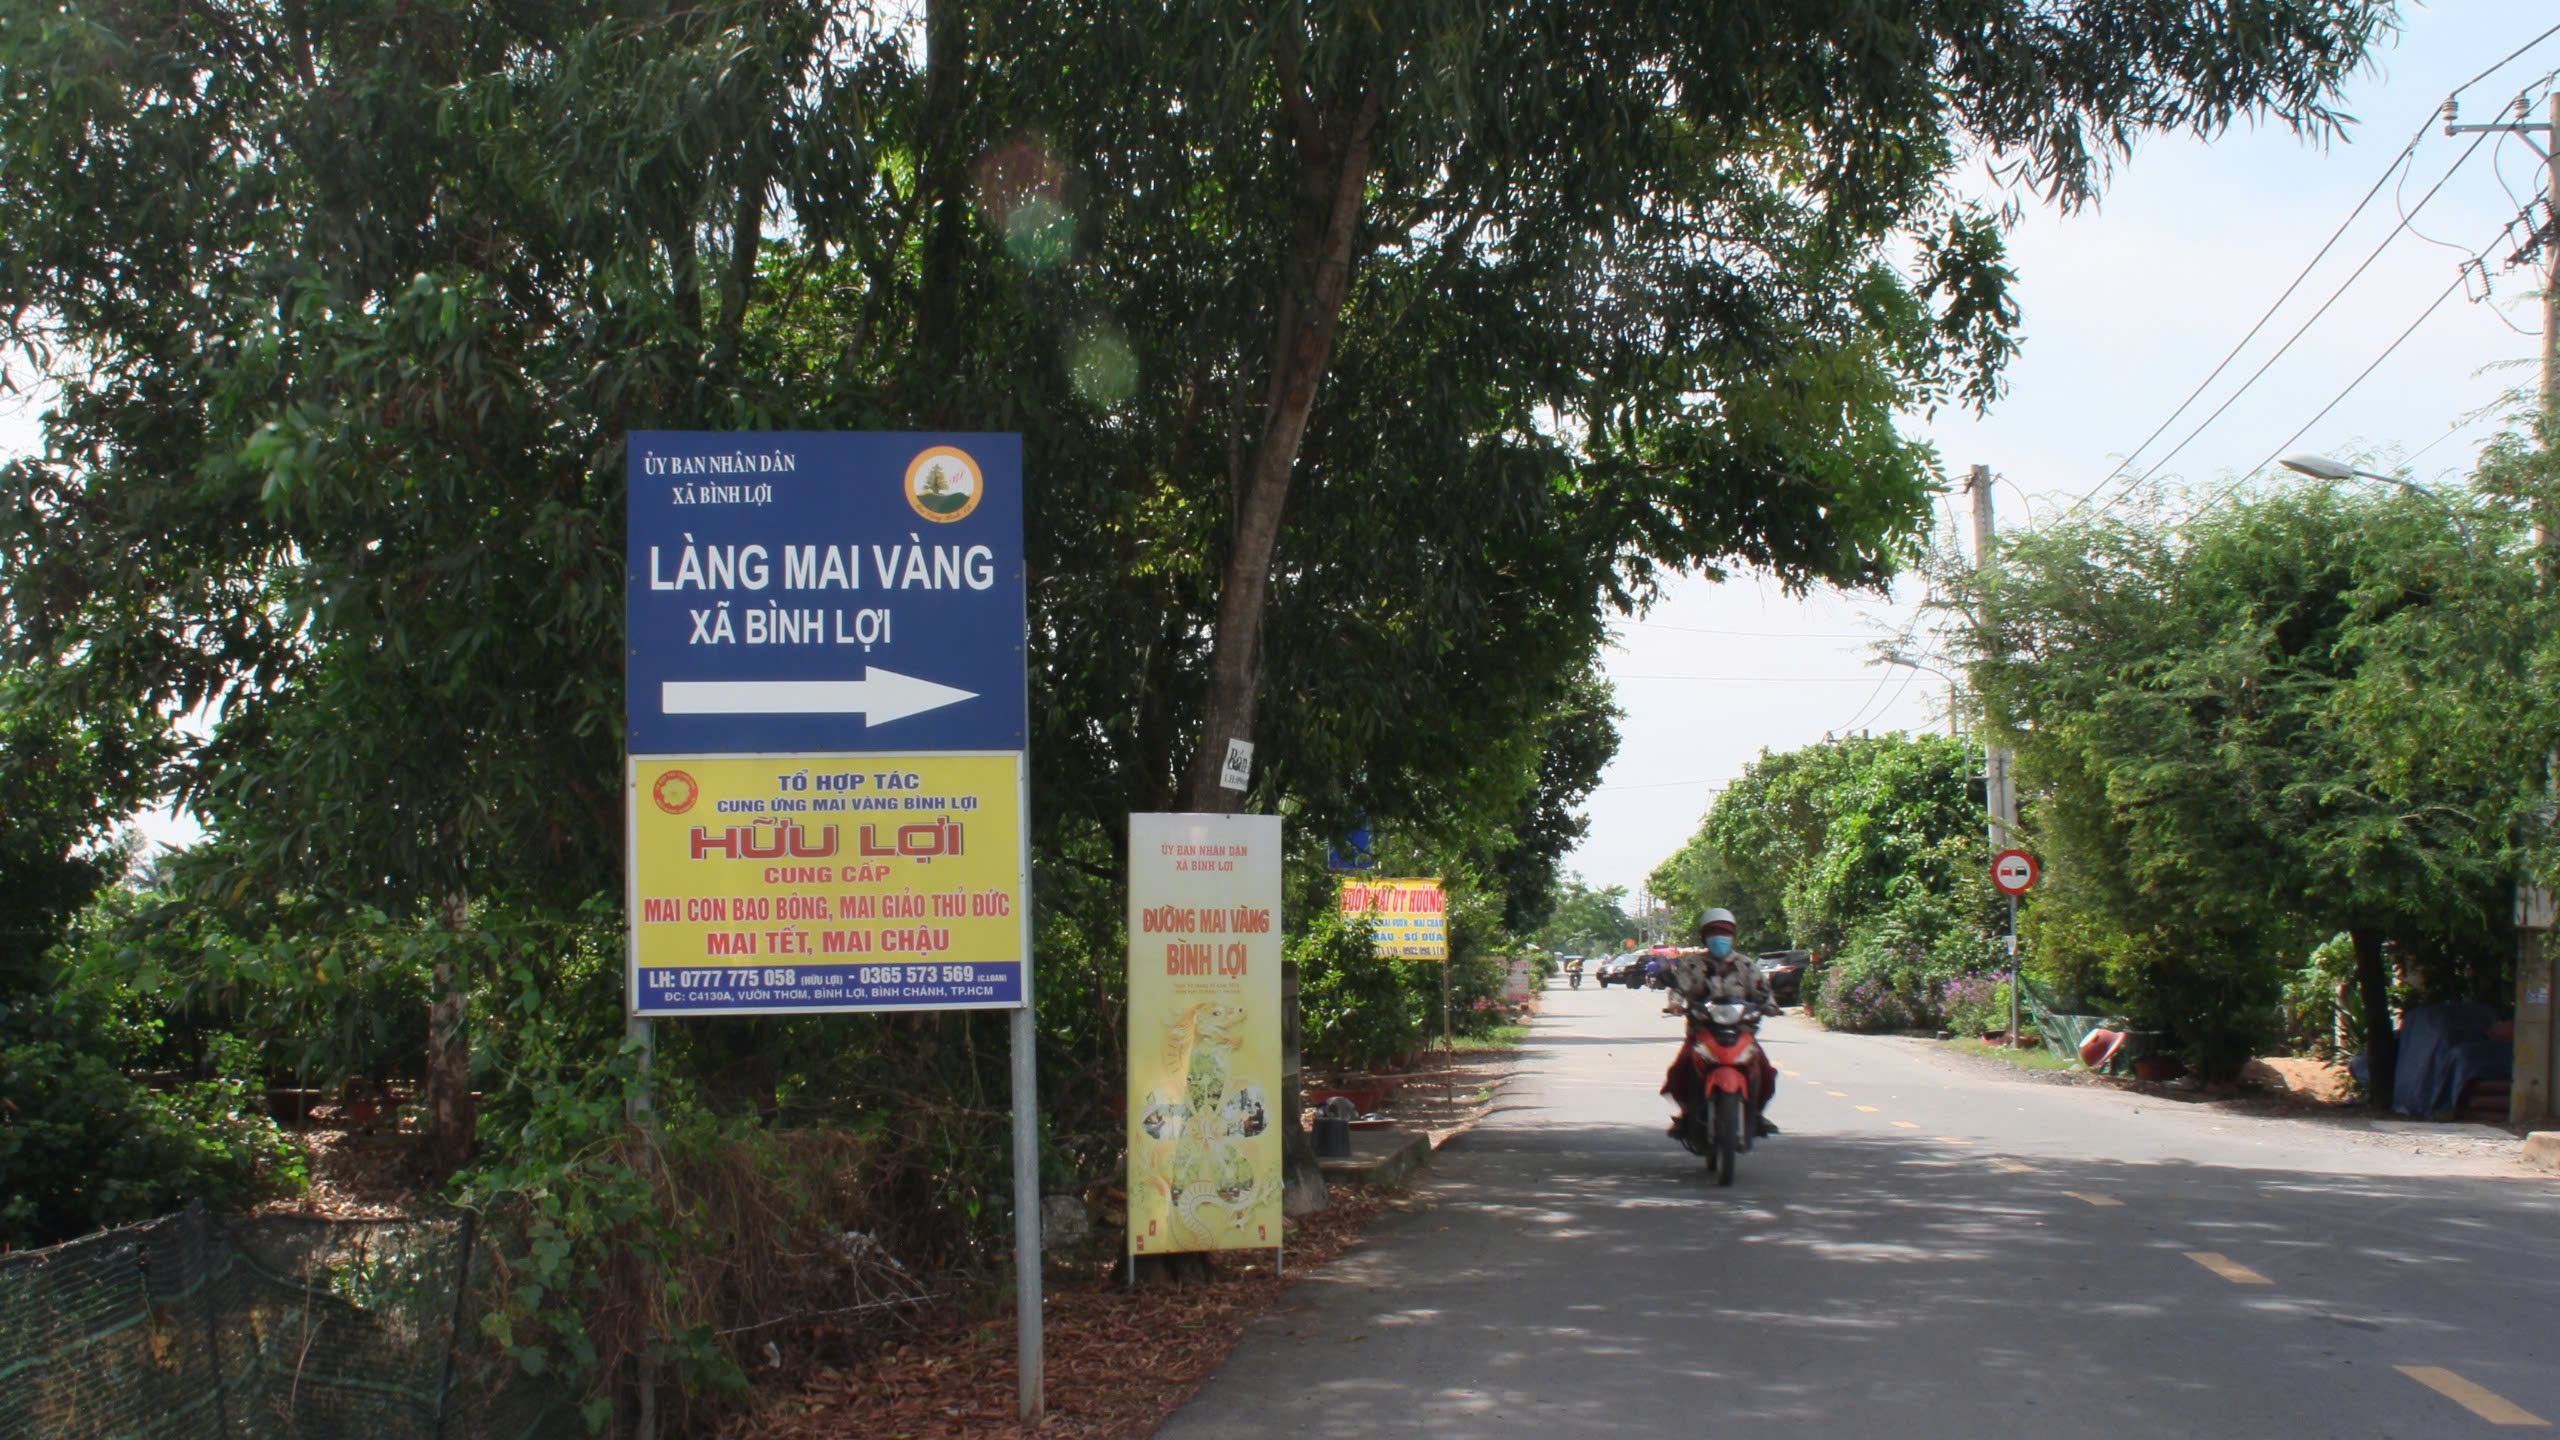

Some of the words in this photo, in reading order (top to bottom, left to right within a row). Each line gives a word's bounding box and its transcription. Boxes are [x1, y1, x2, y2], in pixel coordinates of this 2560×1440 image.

[645, 451, 667, 475] ỦY
[671, 456, 706, 474] BAN
[709, 450, 756, 473] NHÂN
[760, 449, 795, 472] DÂN
[672, 482, 696, 504] XÃ
[700, 480, 740, 504] BÌNH
[744, 482, 773, 507] LỢI
[651, 533, 769, 590] LÀNG
[784, 545, 859, 590] MAI
[872, 533, 994, 590] VÀNG
[689, 600, 736, 644] XÃ
[746, 599, 824, 644] BÌNH
[836, 608, 890, 652] LỢI
[778, 768, 808, 791] TỔ
[816, 773, 865, 794] HỢP
[873, 770, 919, 790] TÁC
[717, 800, 765, 812] CUNG
[771, 797, 807, 812] ỨNG
[812, 799, 846, 811] MAI
[852, 796, 898, 810] VÀNG
[904, 795, 945, 809] BÌNH
[951, 796, 977, 811] LỢI
[690, 816, 838, 859] HỮU
[860, 815, 964, 864] LỢI
[764, 866, 833, 884] CUNG
[841, 860, 891, 883] CẤP
[644, 898, 681, 922] MAI
[687, 898, 726, 921] CON
[732, 897, 770, 921] BAO
[776, 892, 833, 920] BÔNG,
[839, 895, 875, 918] MAI
[882, 887, 926, 918] GIẢO
[931, 886, 966, 917] THỦ
[972, 888, 1010, 917] ĐỨC
[1143, 904, 1195, 933] ĐƯỜNG
[1200, 909, 1226, 933] MAI
[1230, 904, 1270, 933] VÀNG
[707, 932, 757, 955] MAI
[765, 924, 813, 956] TẾT,
[822, 931, 872, 953] MAI
[880, 925, 950, 956] CHẬU
[1166, 938, 1212, 976] BÌNH
[1218, 941, 1248, 979] LỢI
[649, 971, 676, 988] LH:
[680, 970, 722, 988] 0777
[727, 969, 759, 987] 775
[764, 969, 796, 986] 058
[860, 967, 901, 984] 0365
[906, 966, 939, 983] 573
[943, 965, 974, 982] 569
[665, 991, 686, 1002] ĐC:
[688, 991, 735, 1002] C4130A,
[738, 988, 770, 1000] VƯỜN
[773, 989, 811, 1000] THƠM,
[815, 987, 842, 998] BÌNH
[846, 987, 868, 999] LỢI,
[872, 985, 899, 997] BÌNH
[903, 985, 947, 997] CHÁNH,
[952, 986, 993, 996] TP.HCM
